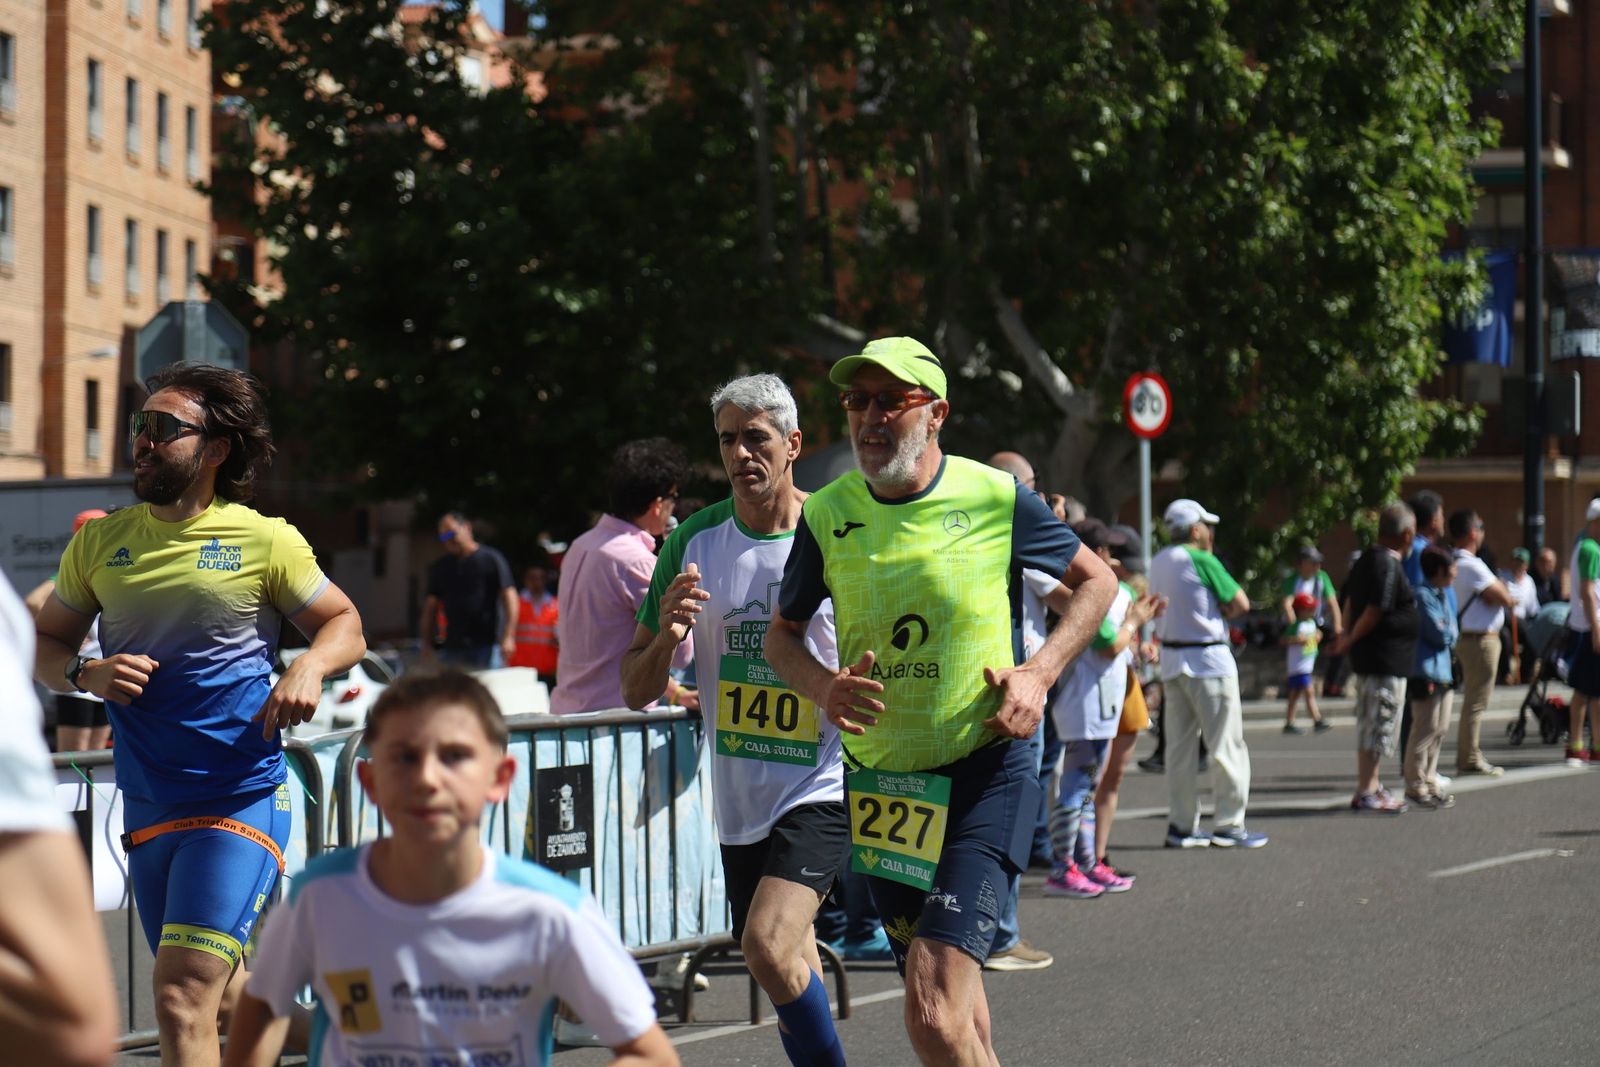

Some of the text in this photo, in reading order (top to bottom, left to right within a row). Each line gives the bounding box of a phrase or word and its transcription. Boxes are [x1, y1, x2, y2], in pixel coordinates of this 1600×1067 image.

[199, 552, 242, 561] TRIATLON
[197, 560, 242, 572] DUERO
[726, 686, 799, 732] 140
[744, 741, 812, 759] CAJA RURAL
[878, 781, 898, 792] CAJA
[173, 819, 194, 830] Club
[196, 818, 237, 831] Triatlon
[858, 797, 935, 850] 227
[547, 841, 587, 858] DE ZAMORA
[880, 858, 931, 882] CAJA RURAL
[186, 935, 228, 953] TRIATLON
